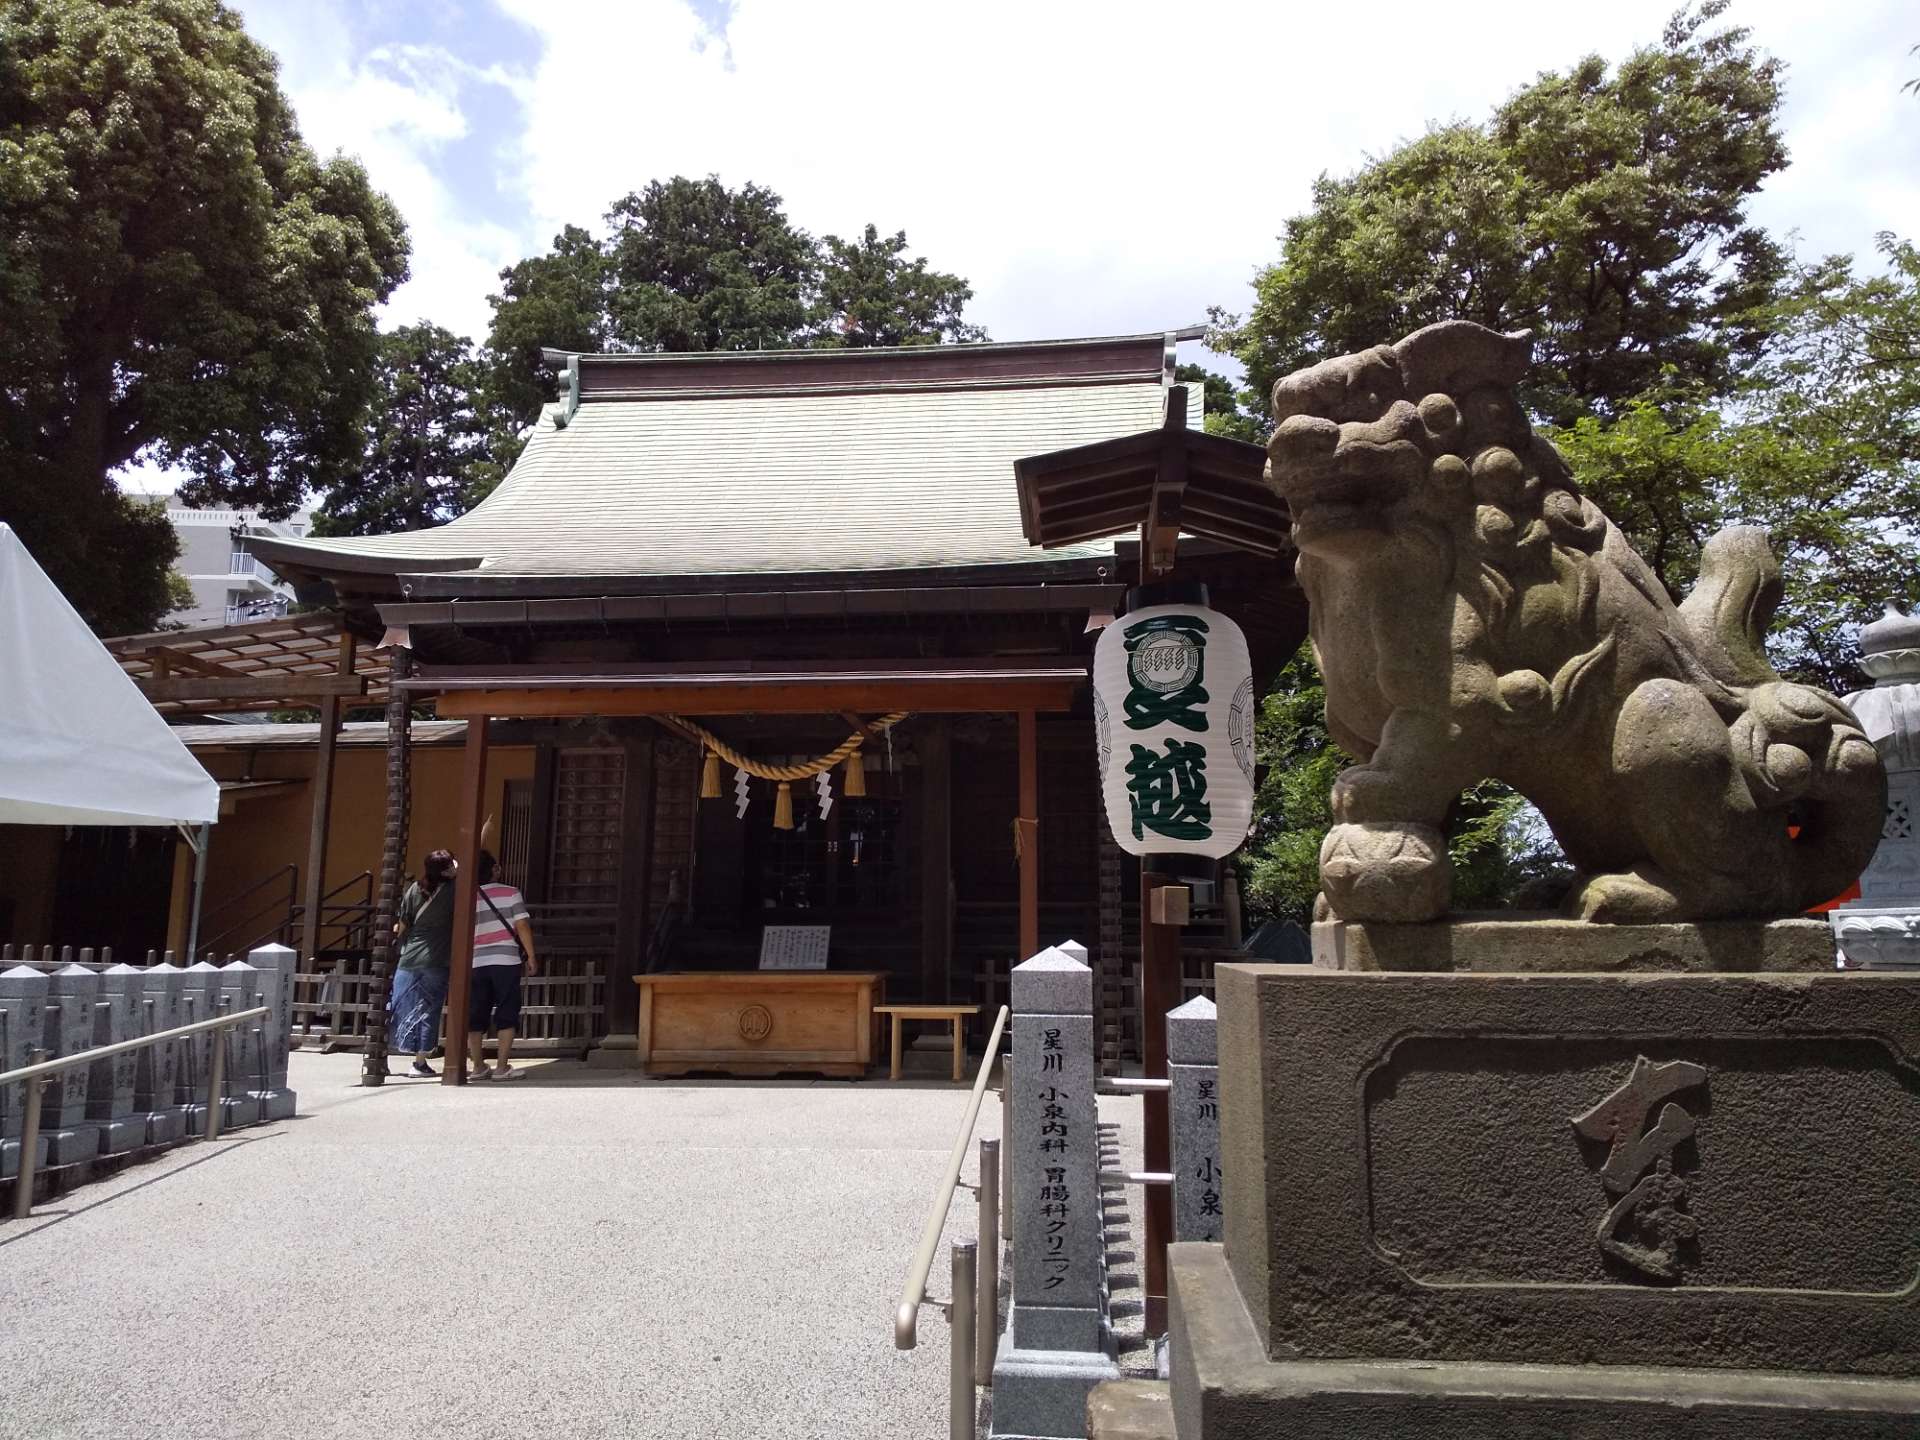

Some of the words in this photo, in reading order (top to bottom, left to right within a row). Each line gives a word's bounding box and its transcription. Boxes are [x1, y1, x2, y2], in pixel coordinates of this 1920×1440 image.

[1042, 1028, 1064, 1073] 星川
[1198, 1079, 1217, 1121] 星川
[1039, 1085, 1070, 1290] 小泉内科・胃腸科クリニック
[1197, 1156, 1223, 1243] 小泉
